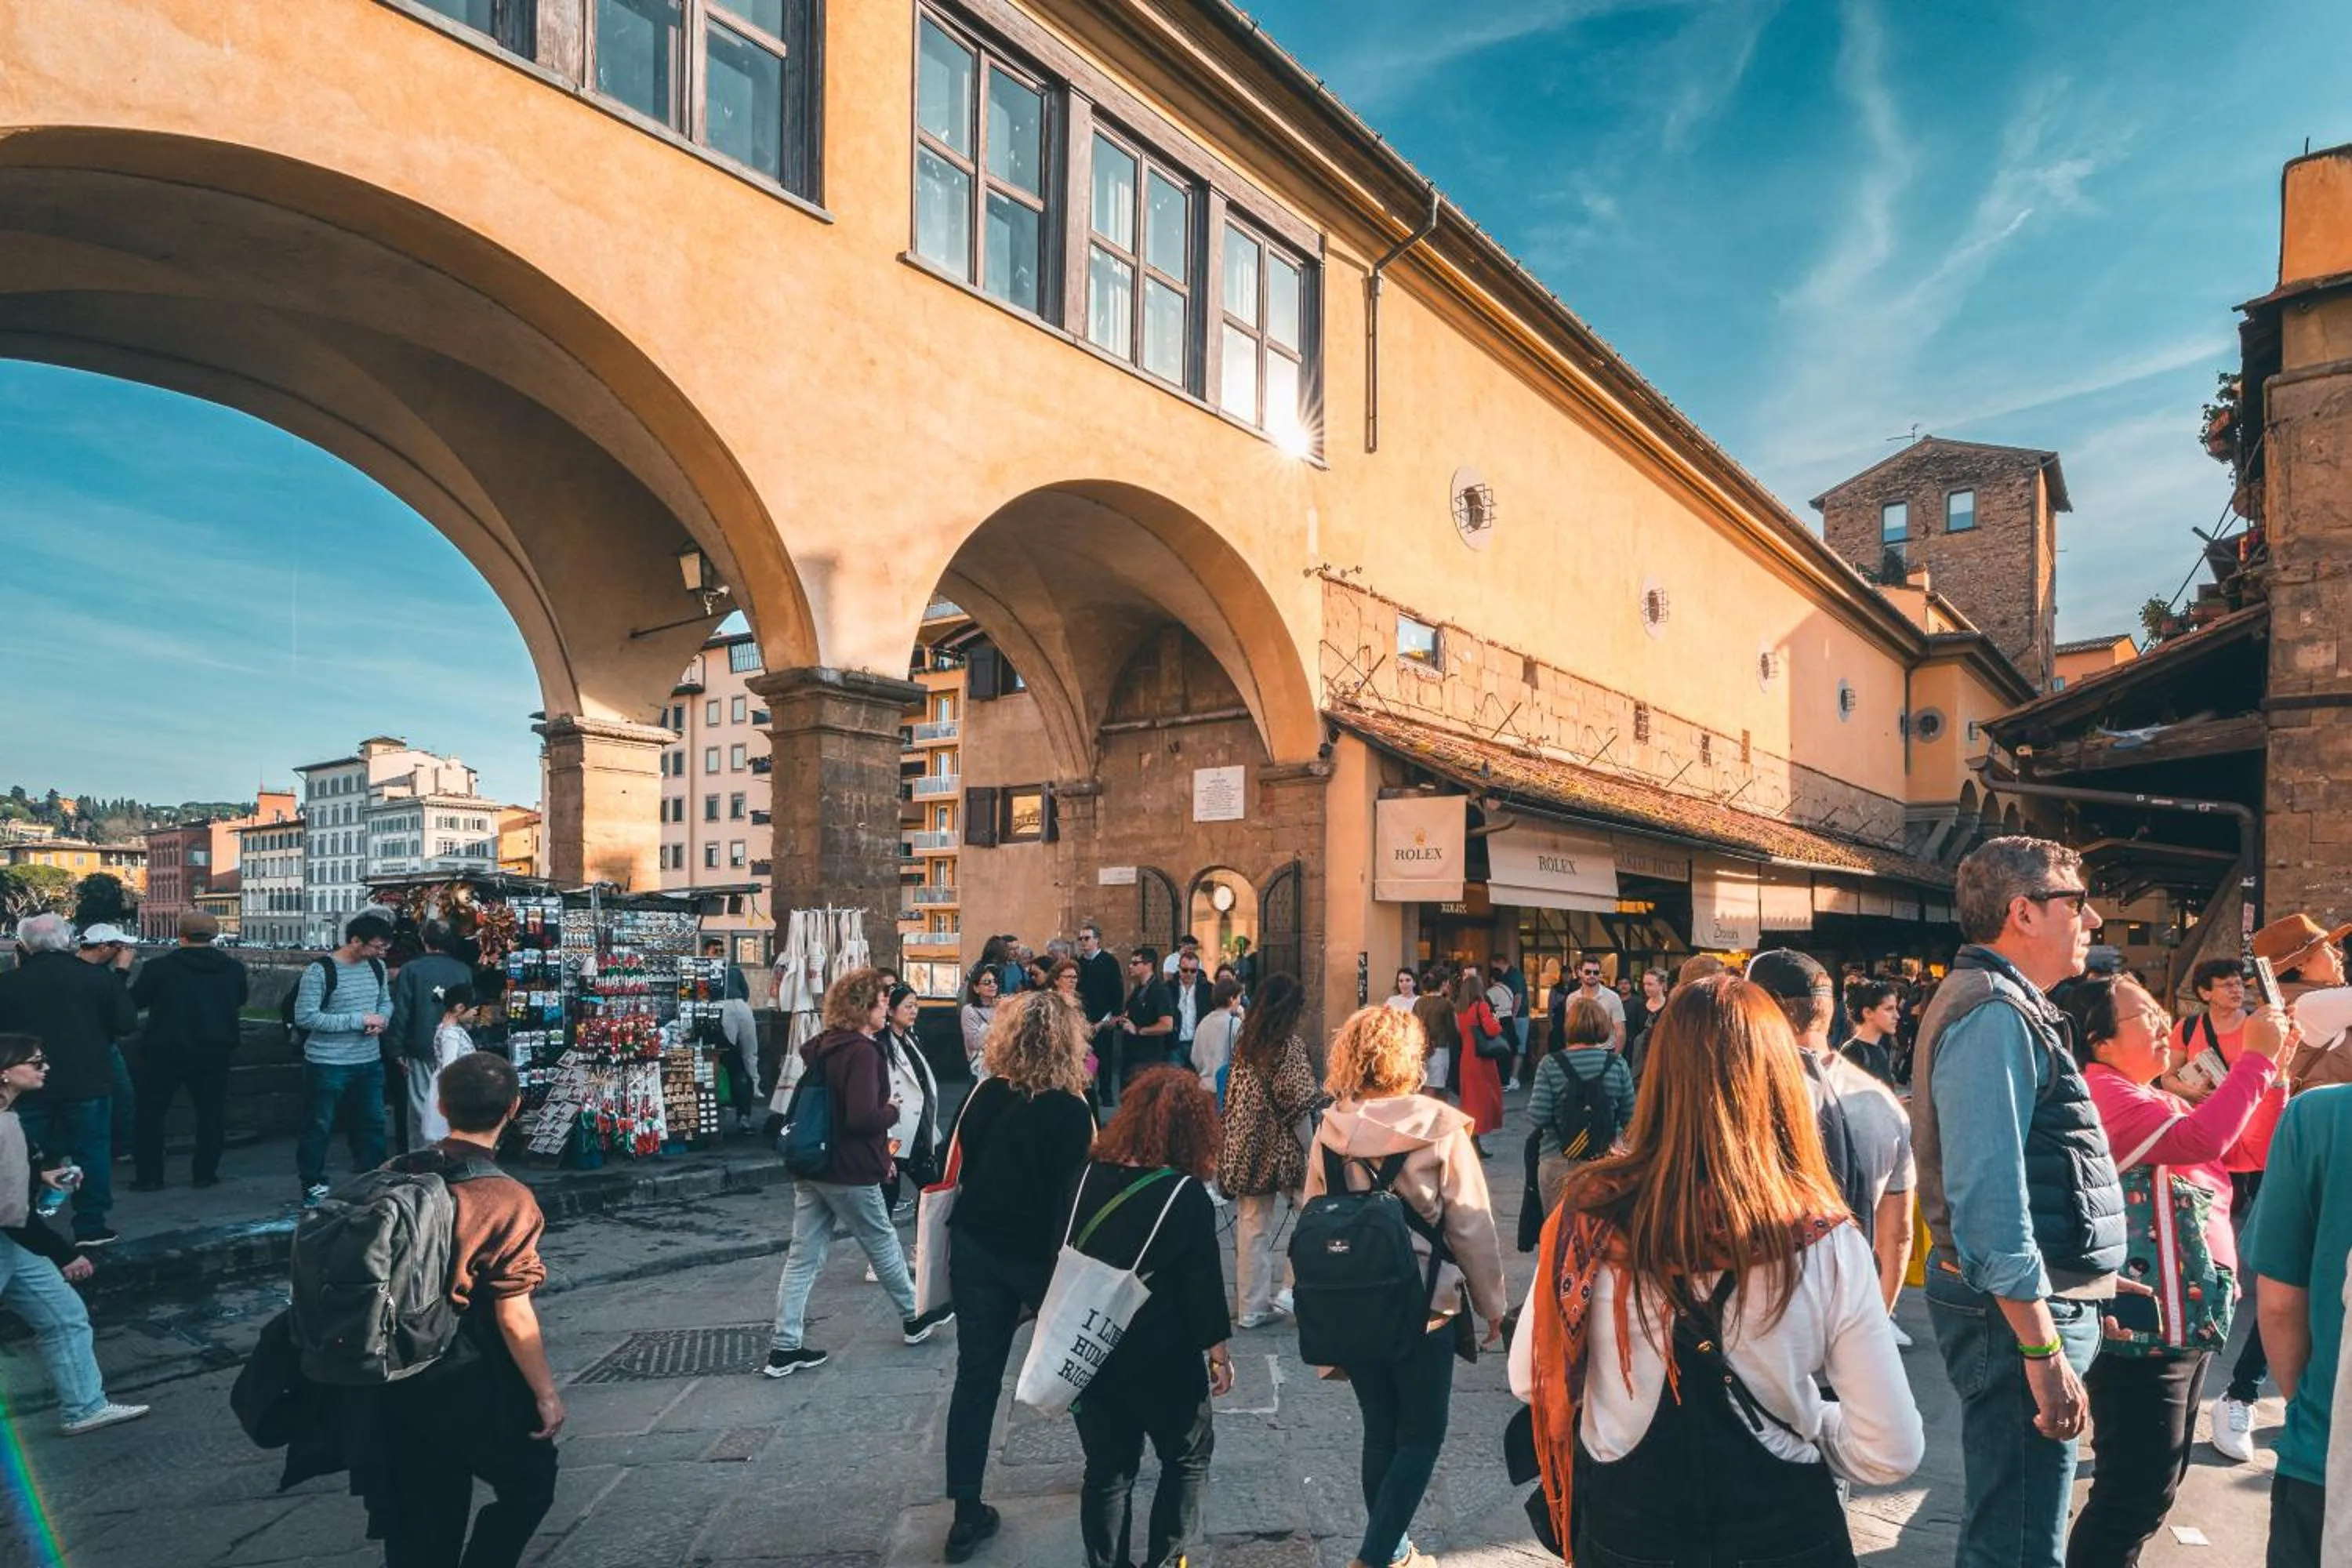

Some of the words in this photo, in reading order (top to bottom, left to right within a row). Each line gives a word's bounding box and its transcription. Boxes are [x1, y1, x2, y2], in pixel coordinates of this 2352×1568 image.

[1395, 848, 1443, 861] ROLEX
[1538, 855, 1577, 876] ROLEX
[1082, 1308, 1099, 1330] I
[1070, 1334, 1107, 1367] HUM
